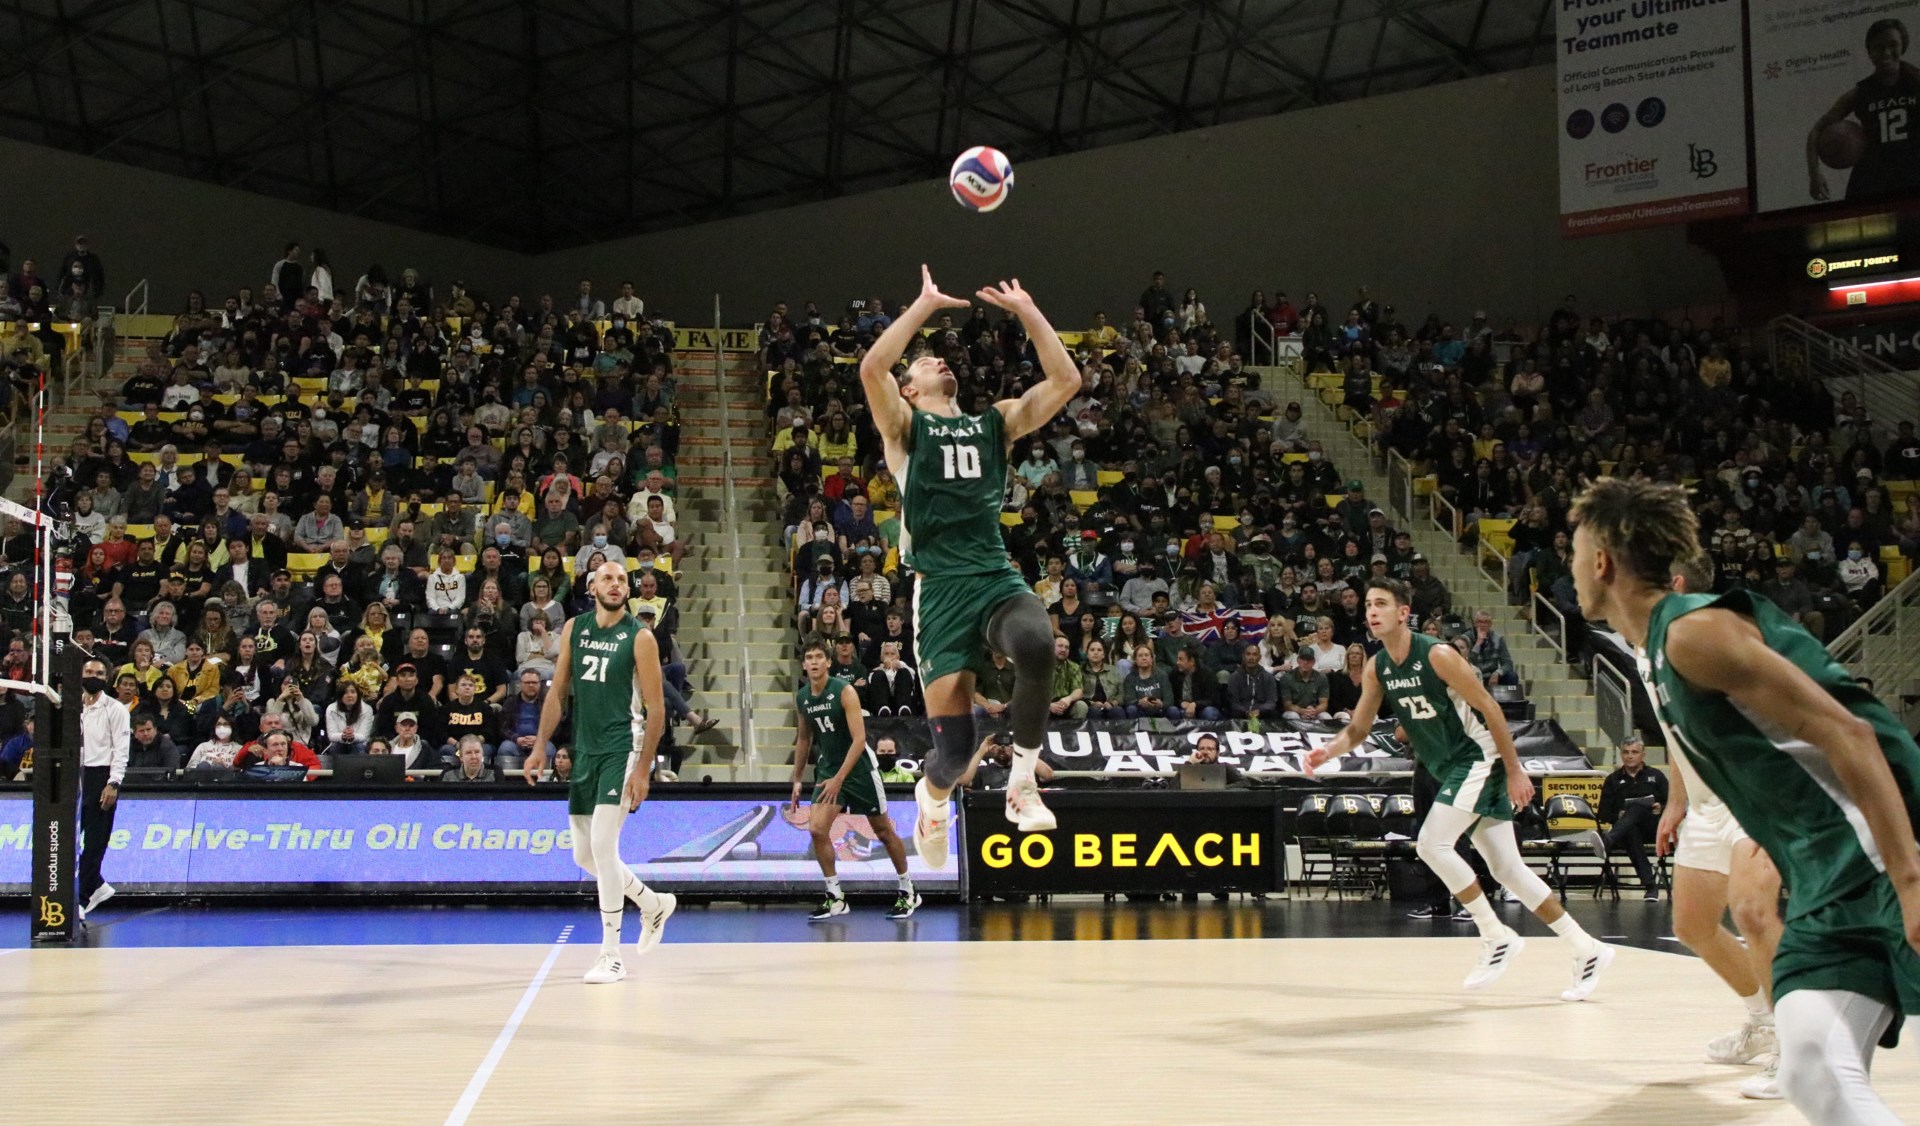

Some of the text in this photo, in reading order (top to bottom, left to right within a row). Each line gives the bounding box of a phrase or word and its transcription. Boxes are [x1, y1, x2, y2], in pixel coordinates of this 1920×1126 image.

[1577, 8, 1626, 34] your
[1563, 22, 1679, 54] Teammate
[1563, 44, 1737, 83] Official Communications Provider
[1563, 60, 1715, 94] of Long Beach State Athletics
[1868, 96, 1917, 112] BEACH
[1878, 107, 1909, 143] 12
[1585, 157, 1659, 181] Frontier
[852, 300, 866, 308] 104
[688, 330, 750, 348] FAME
[940, 443, 982, 479] 10
[579, 638, 620, 652] HAWAII
[580, 655, 610, 683] 21
[1386, 675, 1422, 690] HAWAII
[806, 702, 832, 714] HAWAII
[1398, 695, 1437, 719] 23
[814, 715, 836, 733] 14
[1047, 731, 1177, 757] ULL
[1588, 783, 1604, 791] 104
[141, 823, 355, 851] Drive-Thru
[366, 823, 423, 851] Oil
[432, 823, 575, 855] Change
[981, 832, 1261, 868] GO BEACH
[47, 820, 60, 892] sports imports
